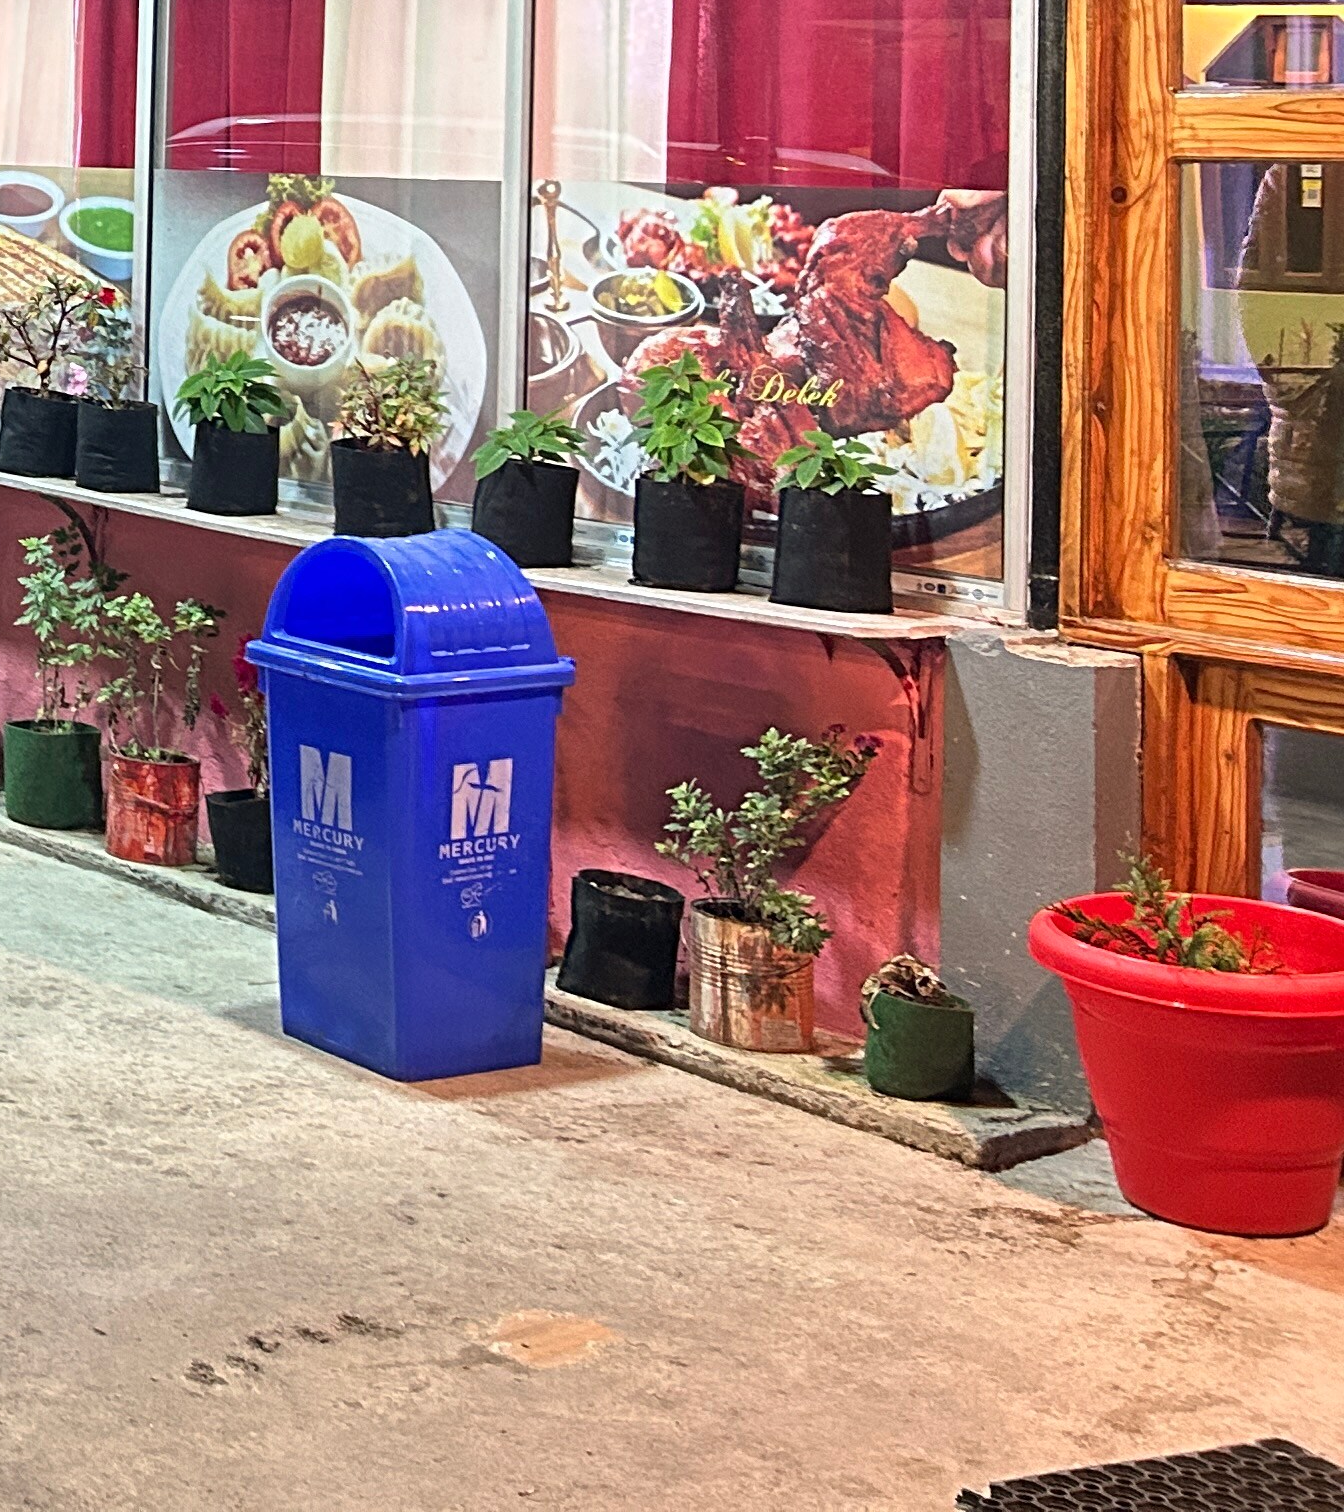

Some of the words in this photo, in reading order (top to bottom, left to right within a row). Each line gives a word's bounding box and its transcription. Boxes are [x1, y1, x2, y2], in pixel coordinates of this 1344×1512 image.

[749, 364, 845, 408] Delek
[293, 818, 364, 851] MERCURY
[439, 833, 521, 860] MERCURY
